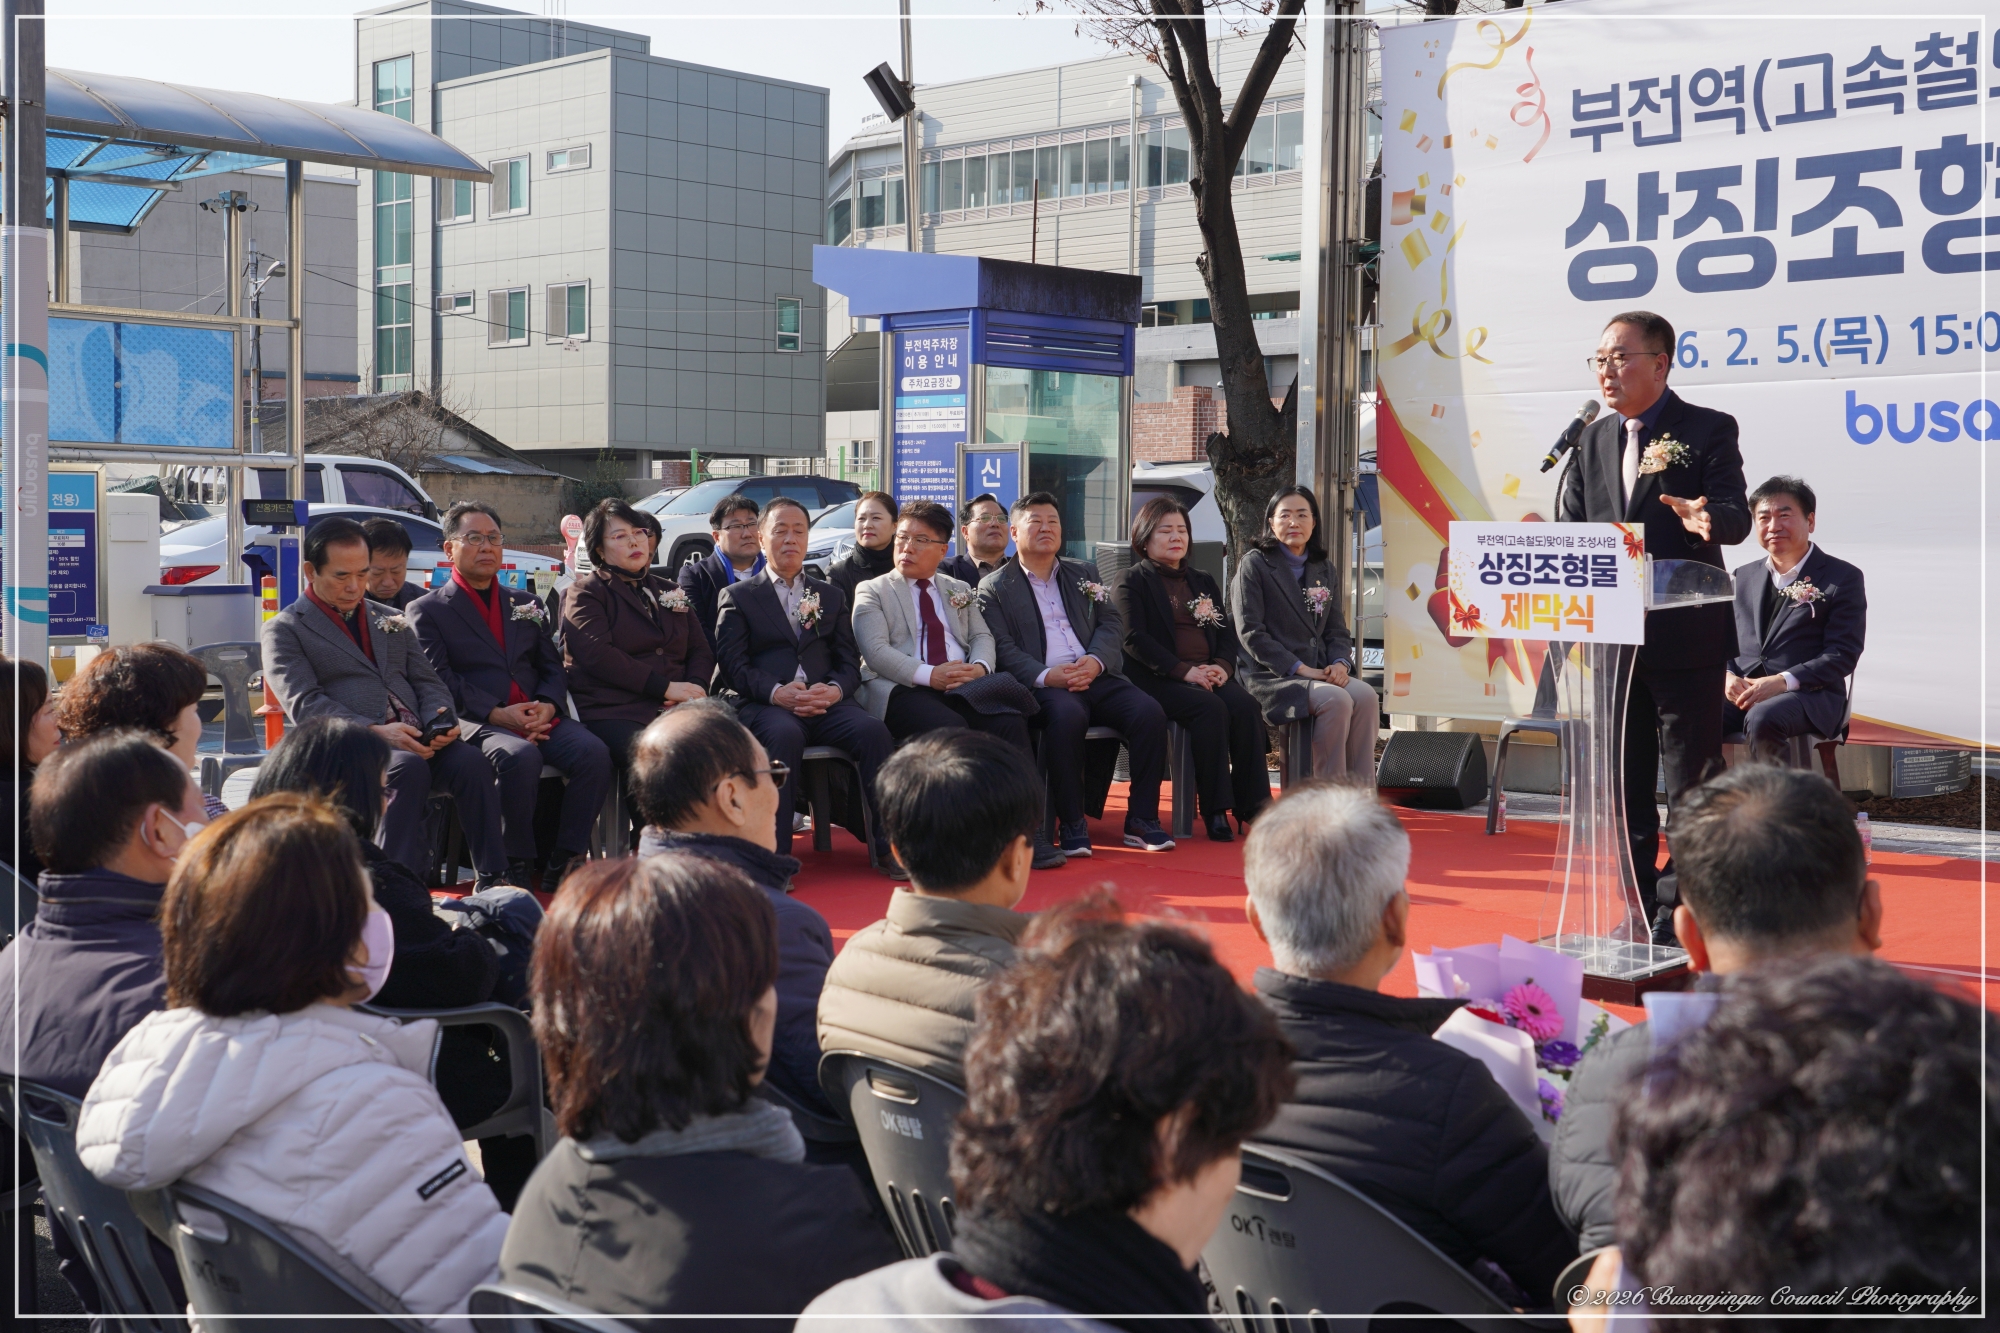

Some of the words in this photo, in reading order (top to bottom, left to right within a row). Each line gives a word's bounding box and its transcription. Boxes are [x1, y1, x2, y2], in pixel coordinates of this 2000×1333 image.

[1570, 28, 2000, 153] 부전역(고속철
[904, 337, 958, 353] 부전역주차장
[1671, 330, 1708, 369] 6.
[1726, 327, 1758, 366] 2.
[905, 354, 928, 370] 이용
[934, 353, 958, 369] 안내
[908, 377, 953, 389] 주차요금정산
[23, 433, 42, 518] busanjin
[52, 493, 80, 507] 전용)
[1477, 534, 1575, 547] 부전역(고속철도)맞이길
[1577, 536, 1617, 549] 조성사업
[1478, 552, 1619, 588] 상징조형물
[1501, 592, 1594, 634] 제막식
